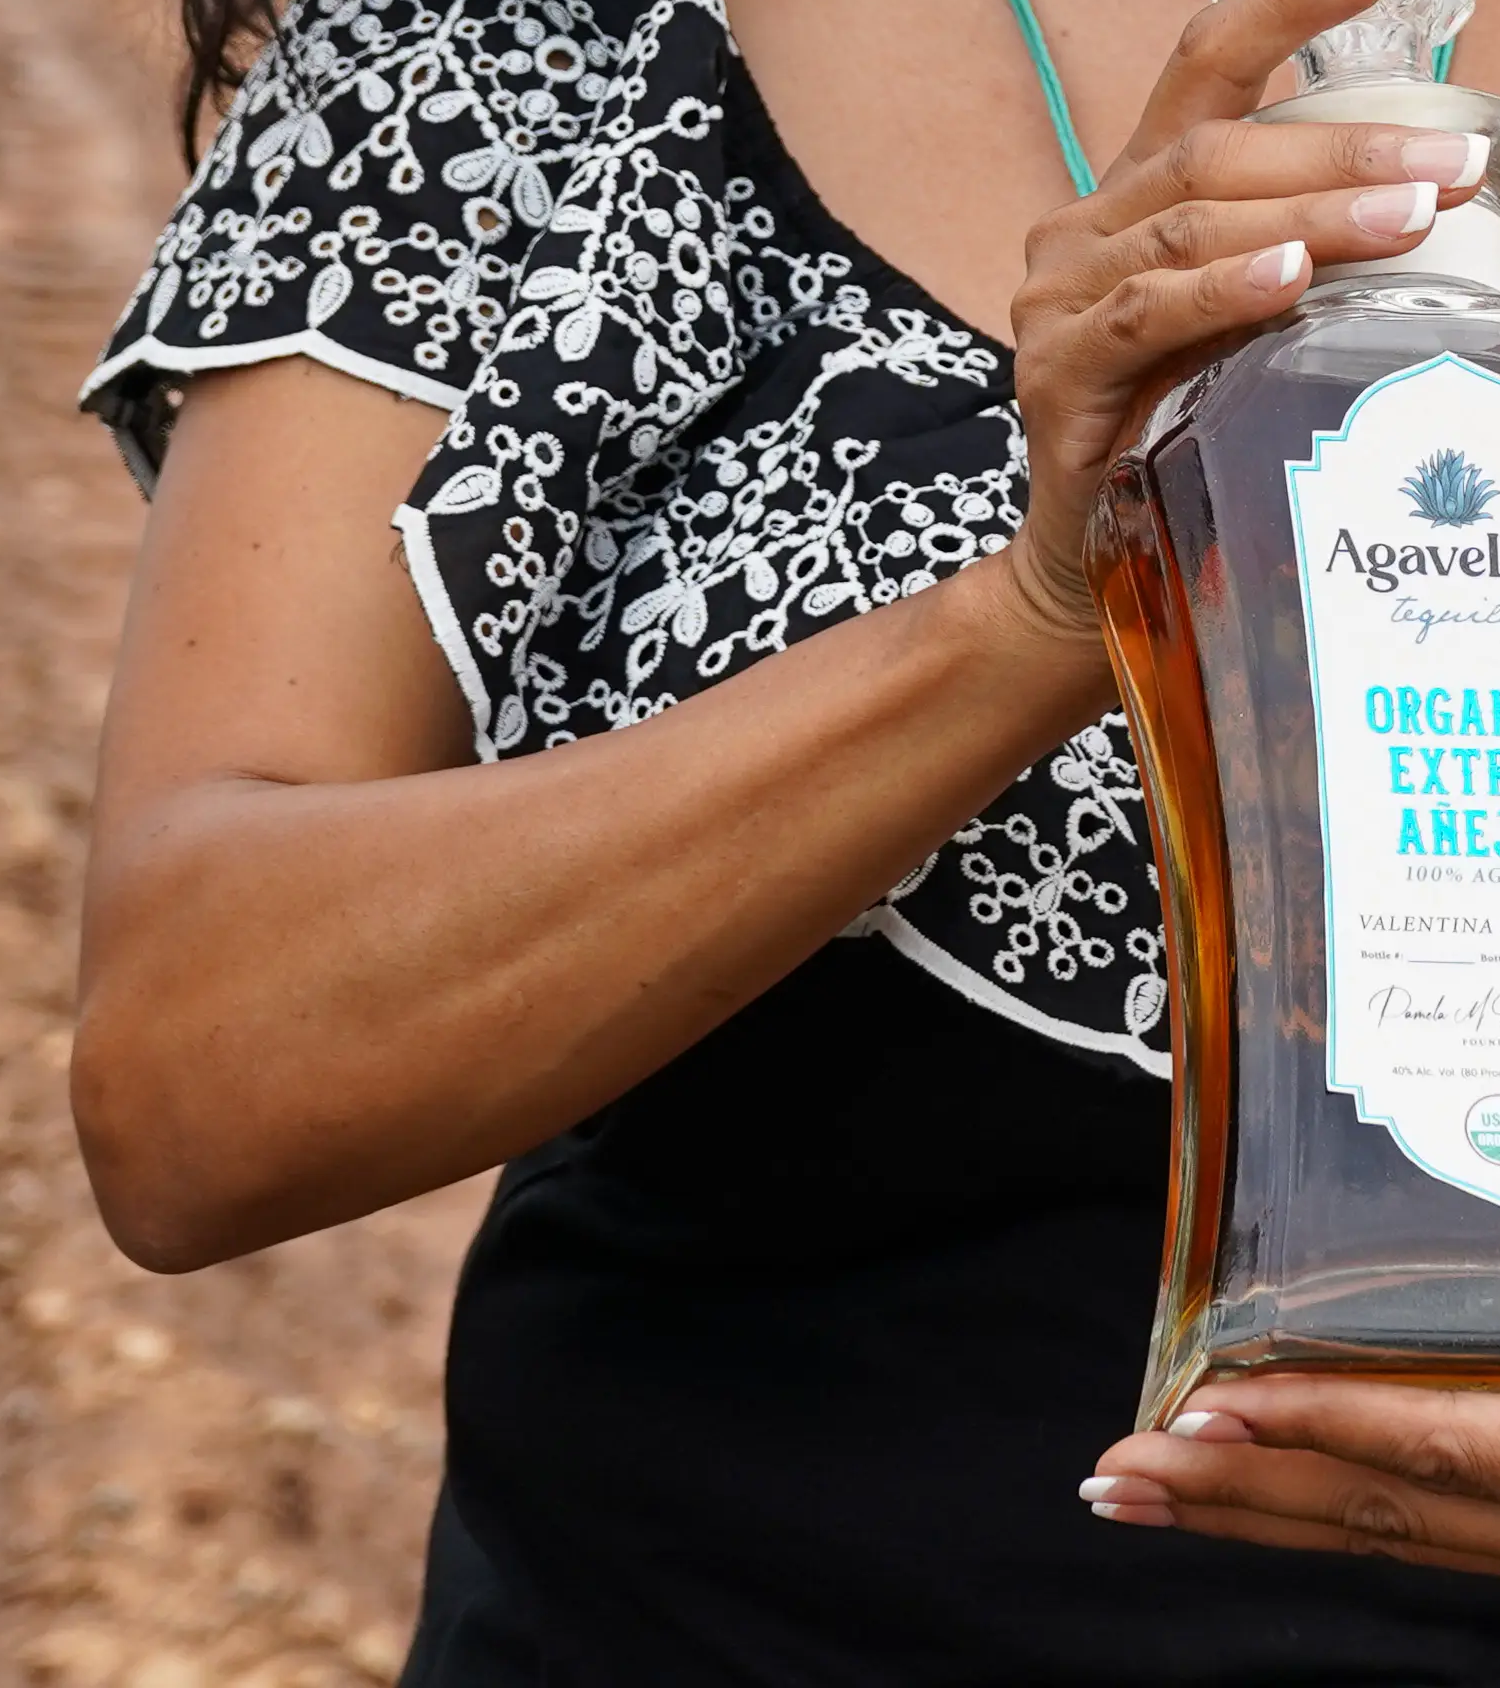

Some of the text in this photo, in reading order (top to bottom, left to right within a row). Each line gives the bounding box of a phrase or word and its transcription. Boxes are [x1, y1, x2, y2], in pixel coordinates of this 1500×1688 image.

[1405, 865, 1463, 883] 100%
[1359, 914, 1493, 934] VALENTINA
[1360, 950, 1391, 960] Bottle
[1392, 1066, 1413, 1076] 40%
